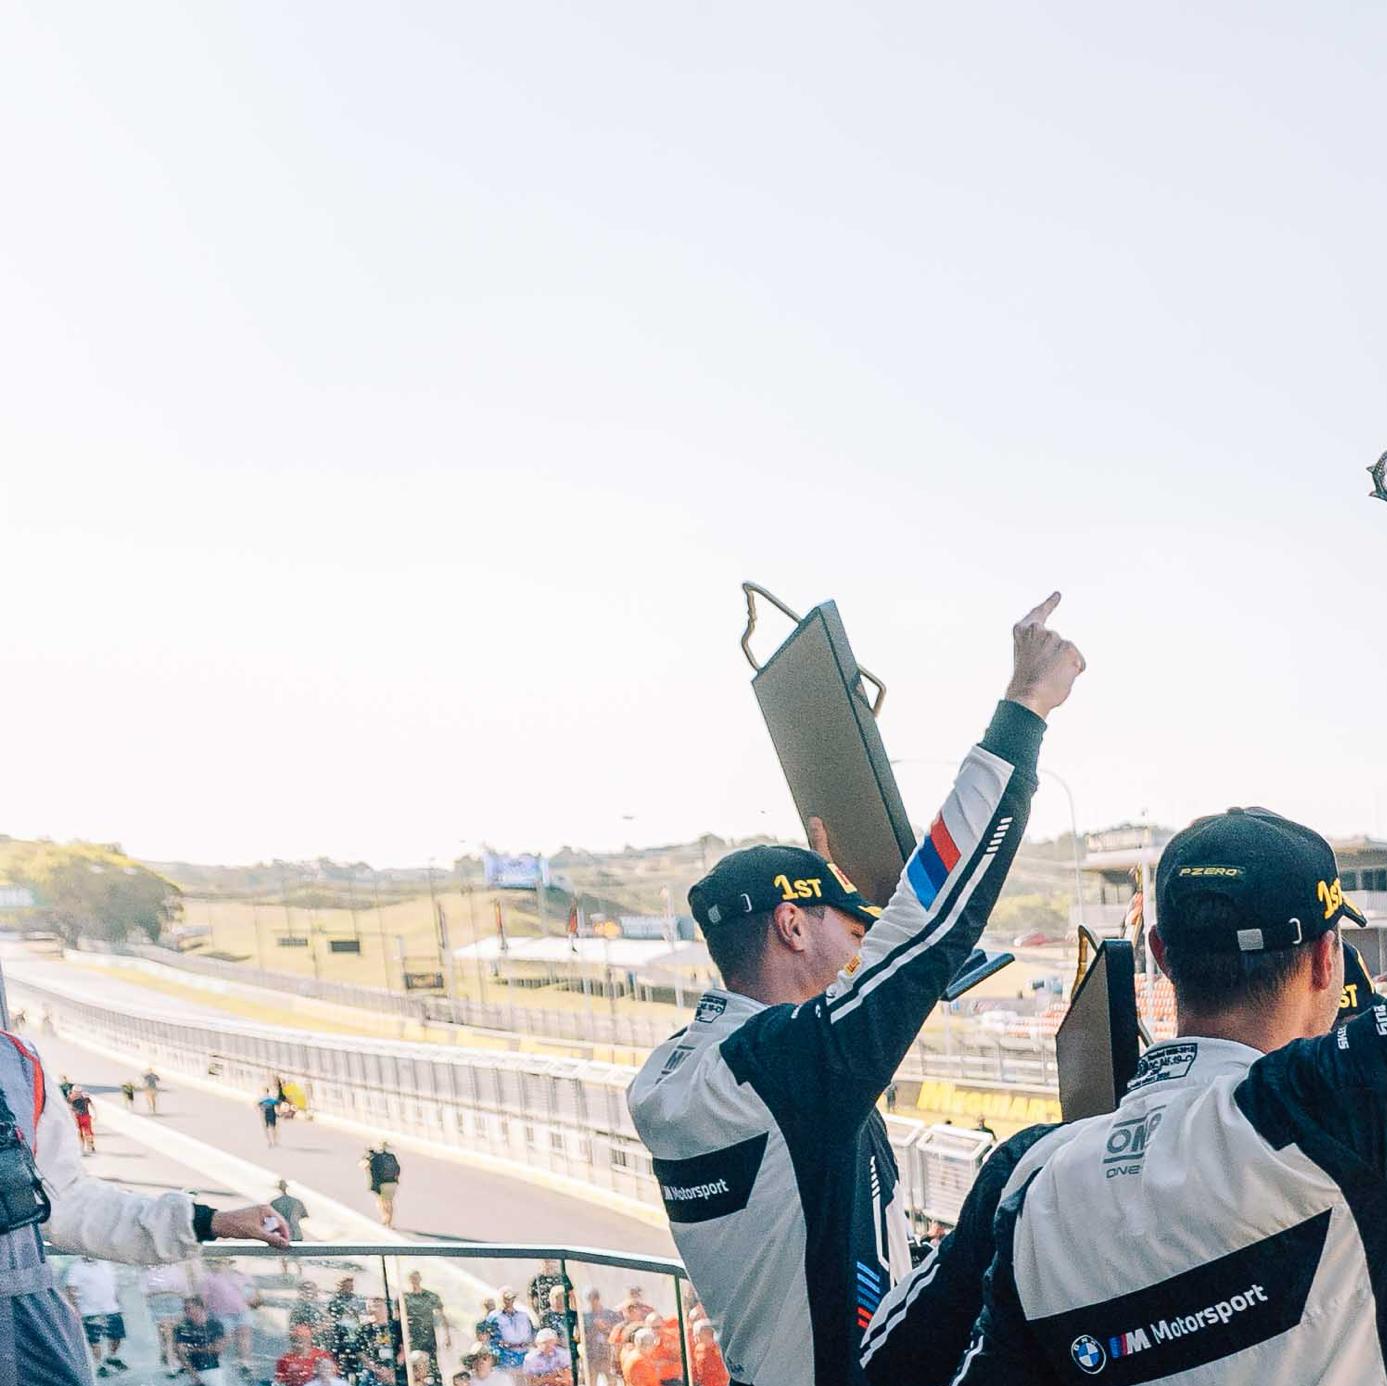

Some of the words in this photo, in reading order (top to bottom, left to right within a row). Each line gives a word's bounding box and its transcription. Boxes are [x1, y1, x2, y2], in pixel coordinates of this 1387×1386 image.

[773, 874, 822, 901] 1ST
[1339, 984, 1358, 1009] ST
[672, 1178, 729, 1200] Motorsport
[1150, 1284, 1269, 1345] Motorsport
